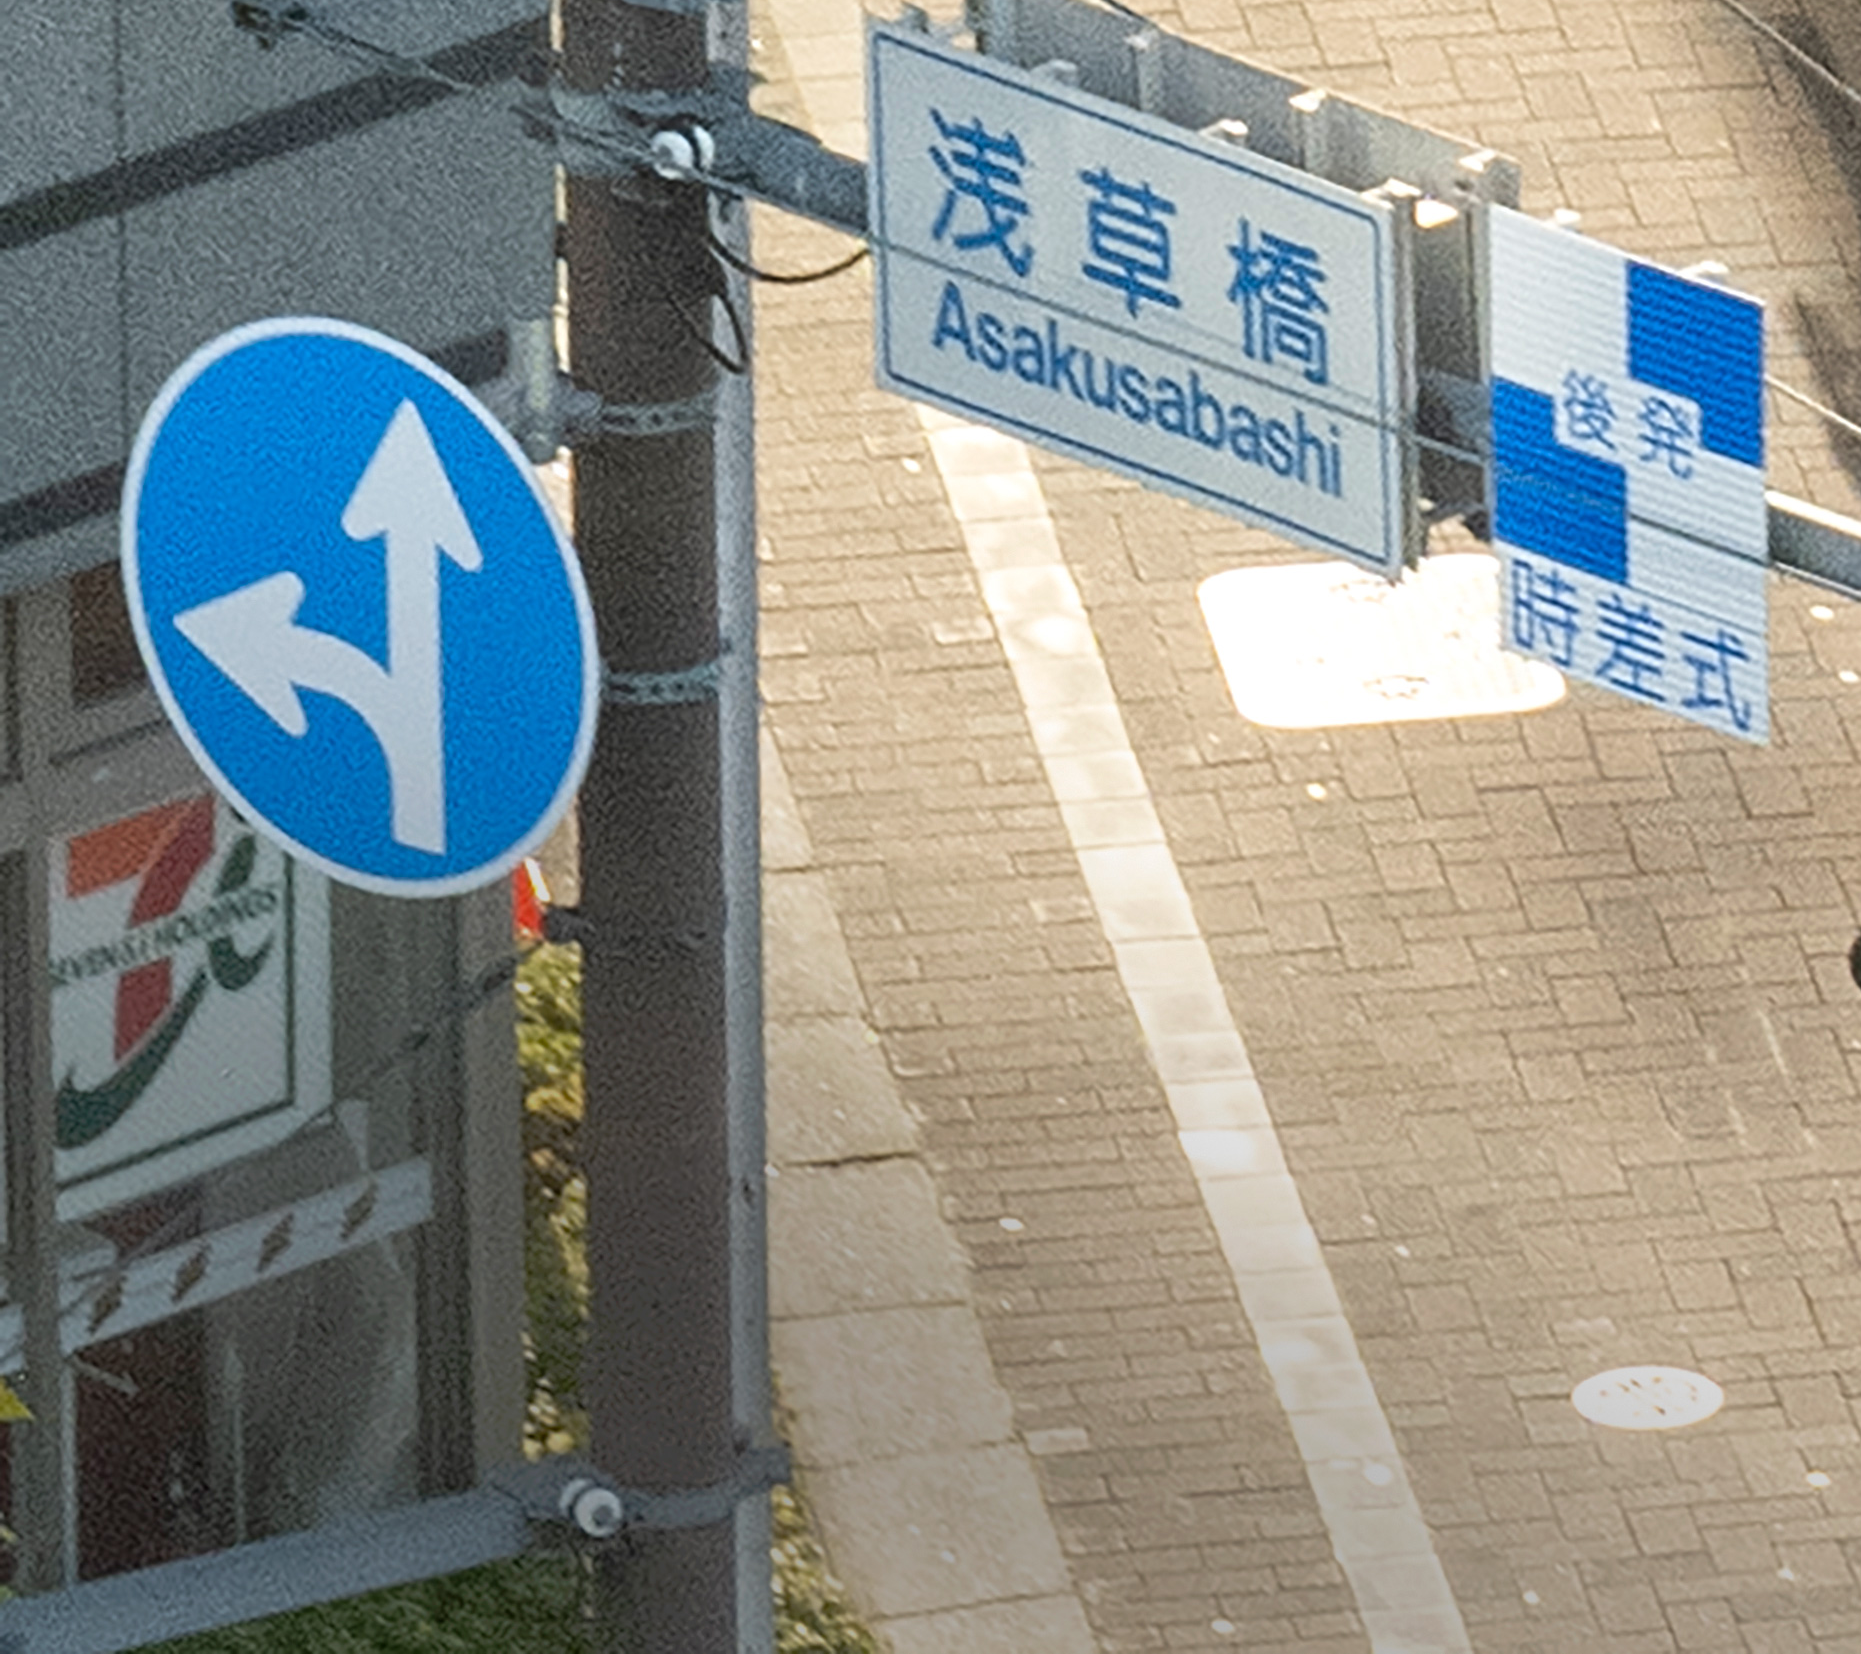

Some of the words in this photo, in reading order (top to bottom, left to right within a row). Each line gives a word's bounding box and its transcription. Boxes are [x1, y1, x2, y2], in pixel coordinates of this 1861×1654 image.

[928, 107, 1331, 386] 浅草橋
[932, 279, 1343, 498] Asakusabashi
[1561, 369, 1695, 481] 後発
[1511, 557, 1751, 732] 時差式
